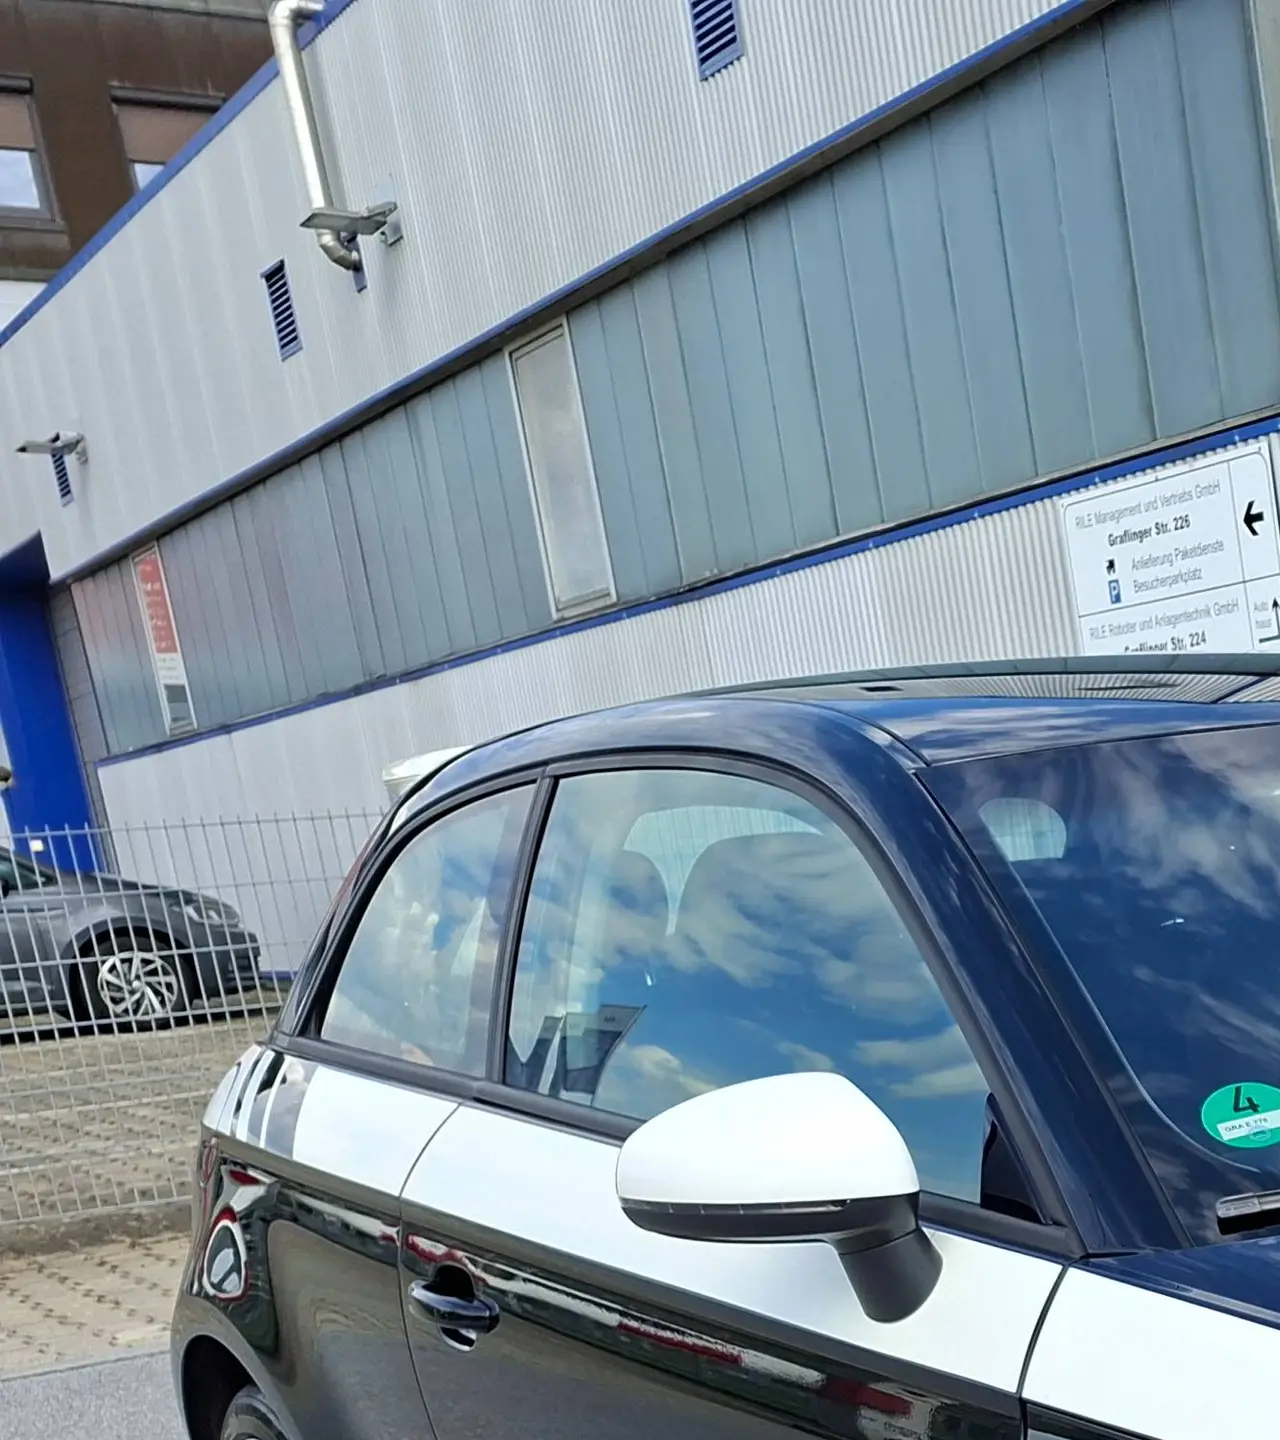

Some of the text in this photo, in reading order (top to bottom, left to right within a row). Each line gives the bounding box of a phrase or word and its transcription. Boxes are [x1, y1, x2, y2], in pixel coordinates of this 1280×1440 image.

[1144, 496, 1159, 512] und
[1195, 479, 1220, 500] GmbH
[1107, 514, 1191, 547] Graflinger Str. 226
[1139, 615, 1153, 631] und
[1213, 598, 1240, 617] GmbH
[1189, 630, 1207, 648] 224
[1233, 1084, 1260, 1113] 4
